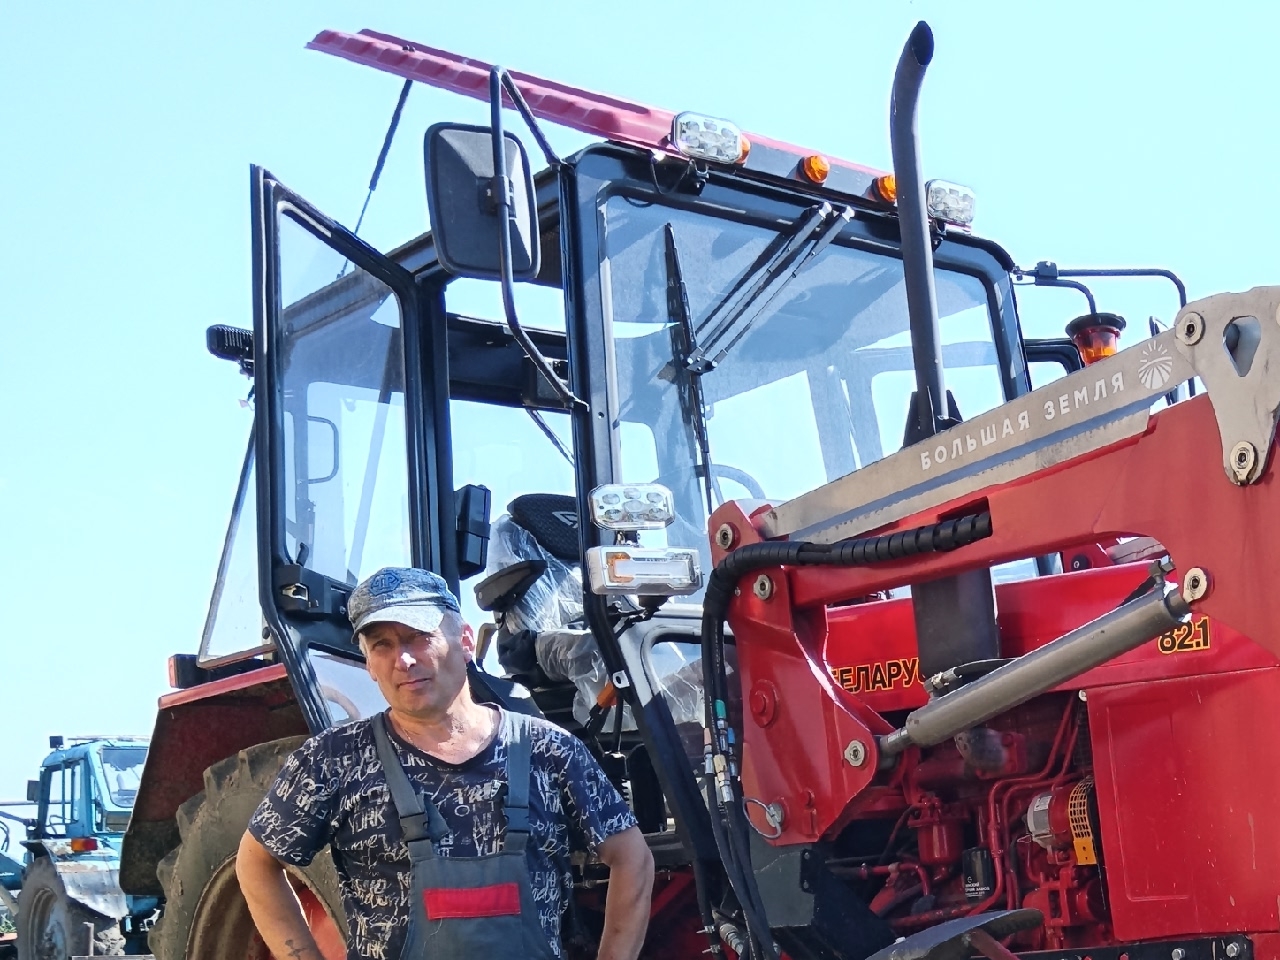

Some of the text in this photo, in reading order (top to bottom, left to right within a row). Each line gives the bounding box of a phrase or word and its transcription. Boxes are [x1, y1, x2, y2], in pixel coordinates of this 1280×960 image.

[920, 371, 1125, 471] БОЛЬШАЯ ЗЕМЛЯ
[1158, 615, 1210, 654] 82.1
